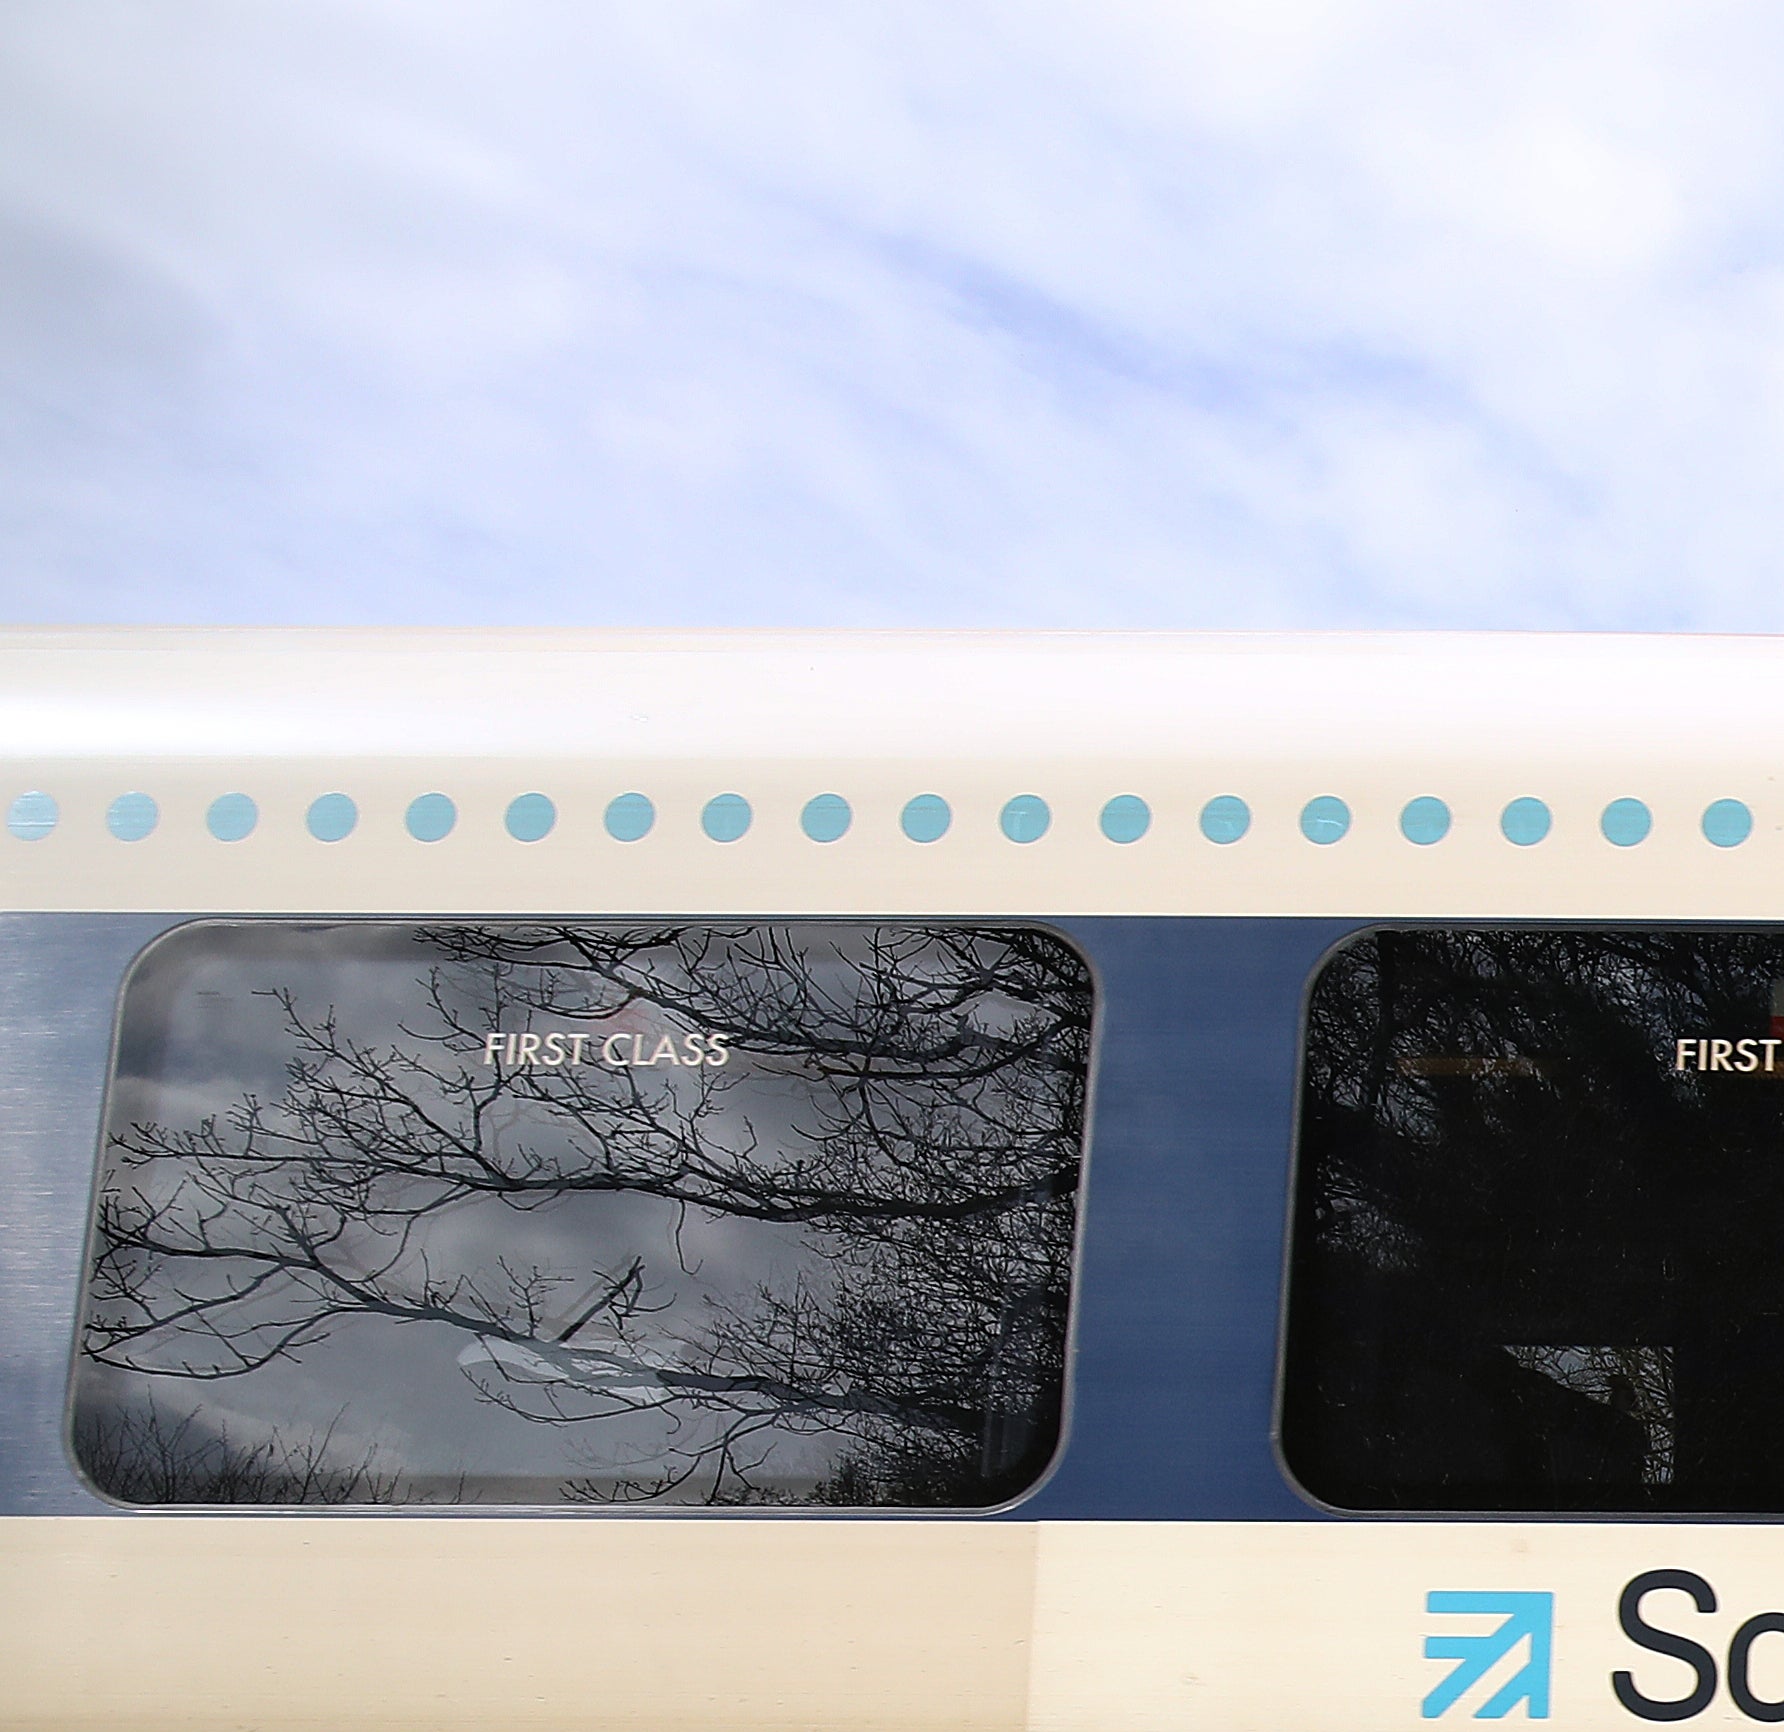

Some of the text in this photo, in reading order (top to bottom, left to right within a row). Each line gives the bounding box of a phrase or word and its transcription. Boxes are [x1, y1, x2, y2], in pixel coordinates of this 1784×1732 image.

[484, 1031, 730, 1067] FIRST CLASS
[1675, 1037, 1783, 1073] FIRST
